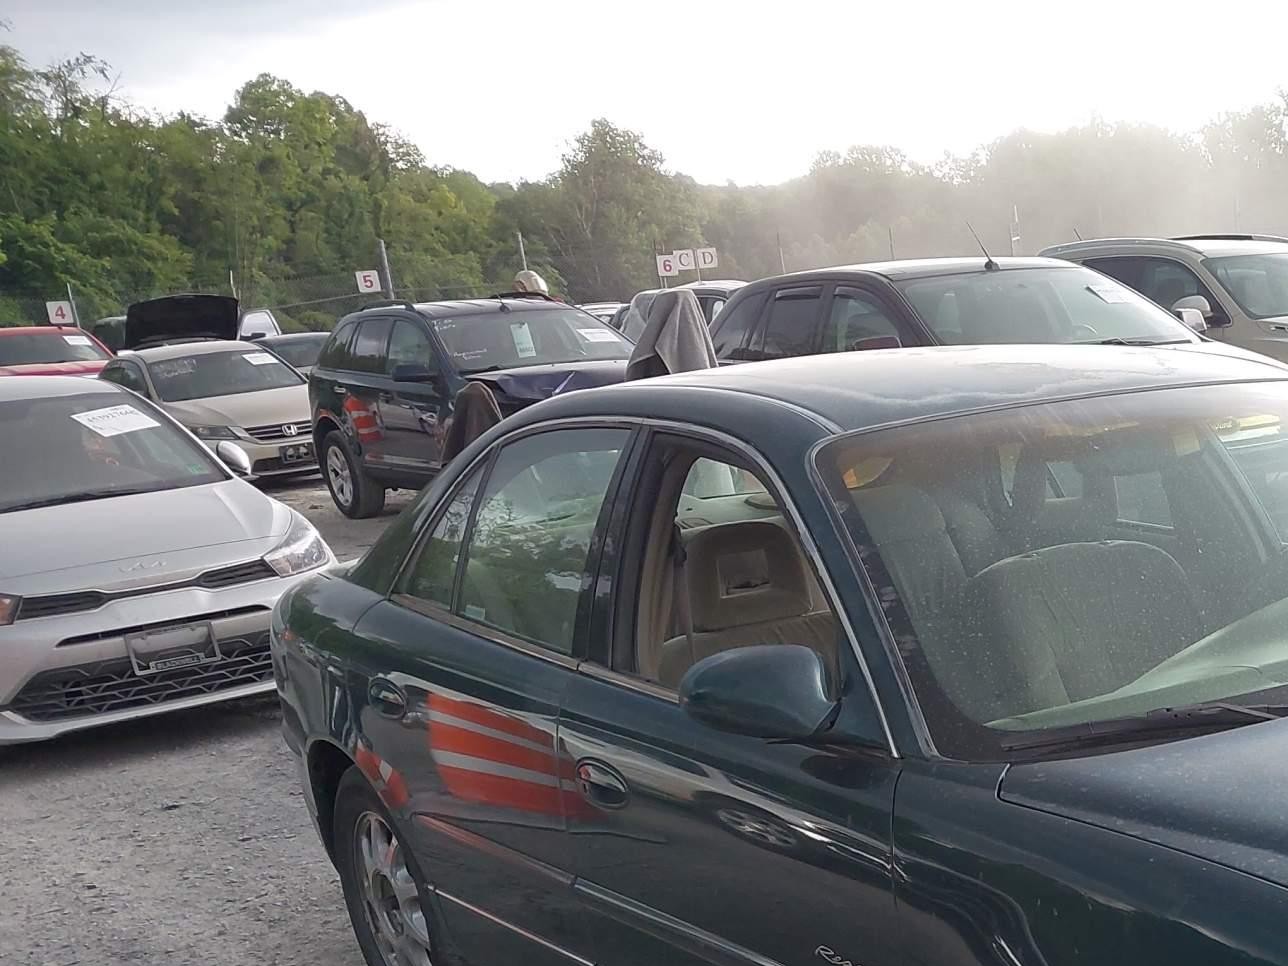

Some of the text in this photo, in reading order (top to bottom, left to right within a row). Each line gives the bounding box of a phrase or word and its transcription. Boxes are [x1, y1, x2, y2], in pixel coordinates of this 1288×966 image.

[678, 252, 689, 266] C
[701, 251, 713, 264] D
[662, 259, 672, 272] 6
[363, 274, 373, 288] 5
[55, 305, 66, 319] 4
